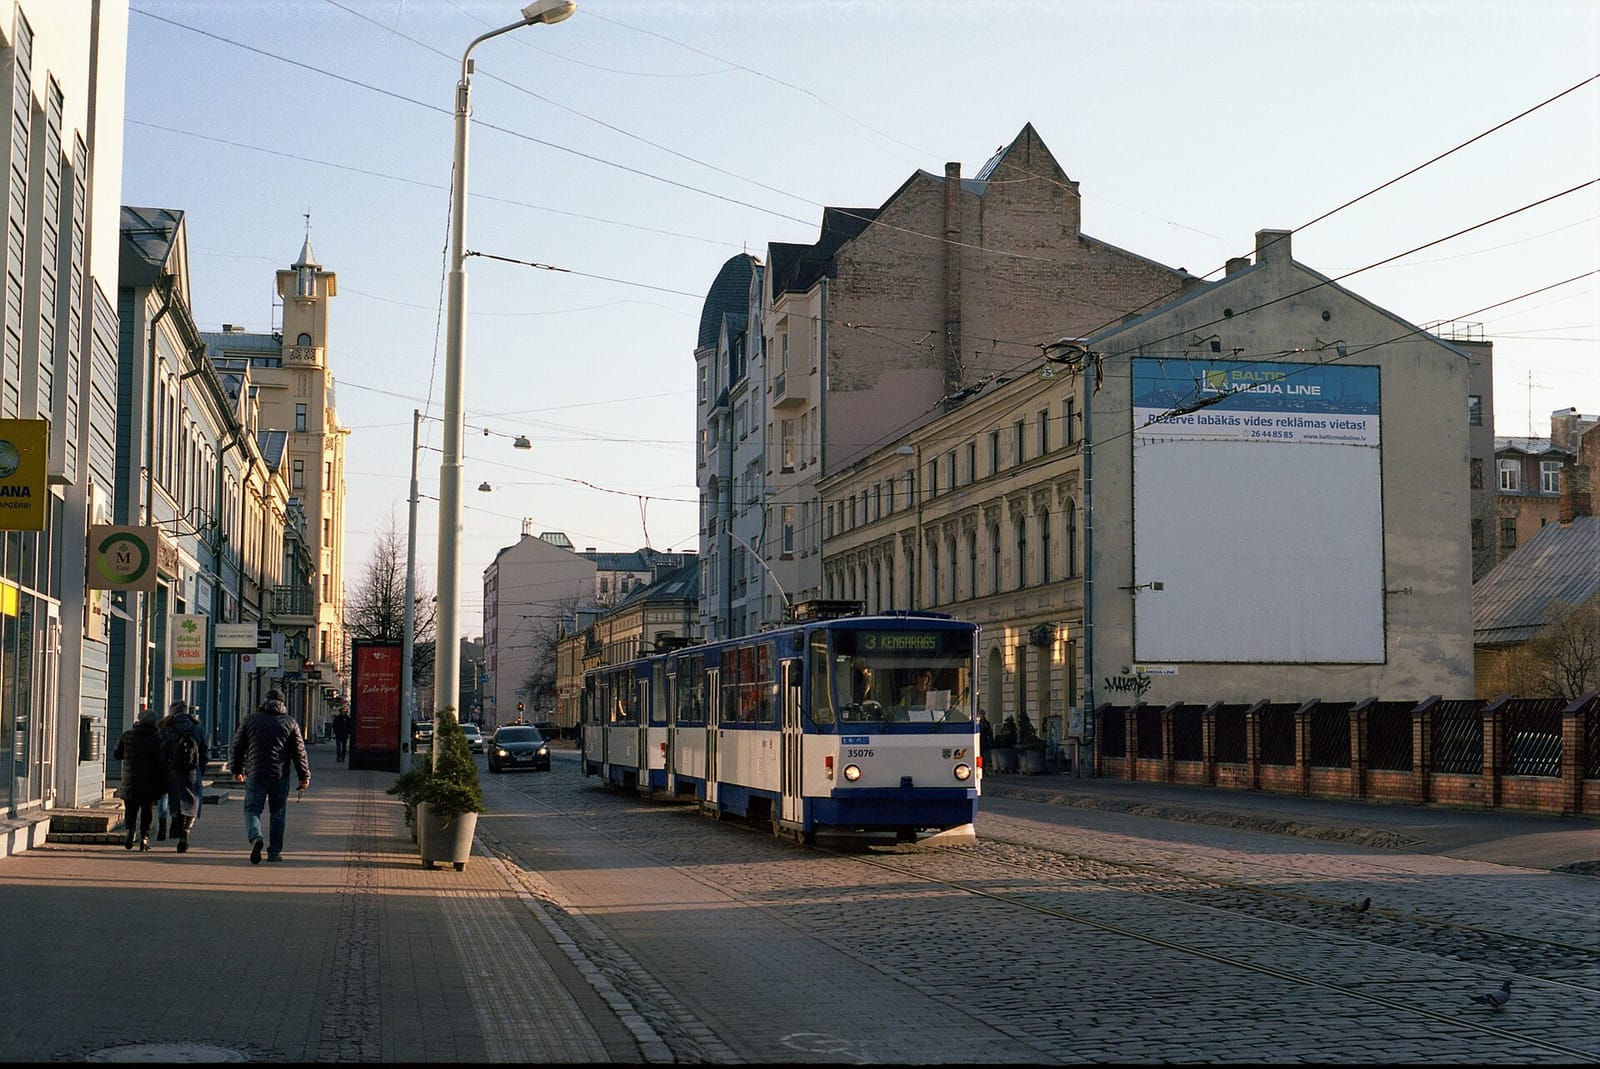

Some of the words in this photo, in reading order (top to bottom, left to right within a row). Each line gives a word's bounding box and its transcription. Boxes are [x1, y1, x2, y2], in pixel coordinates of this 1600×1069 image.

[1231, 370, 1286, 381] BALTIC
[1232, 383, 1283, 394] MEDIA
[1287, 385, 1321, 395] LINE
[1148, 413, 1194, 425] Rezervē
[1197, 414, 1240, 426] labākās
[1243, 416, 1273, 427] vides
[1276, 417, 1327, 429] reklāmas
[1329, 419, 1366, 430] vietas!
[0, 485, 31, 497] ANA
[117, 552, 131, 564] M
[864, 634, 877, 649] 3
[177, 649, 200, 658] Veikals
[847, 749, 874, 758] 35076
